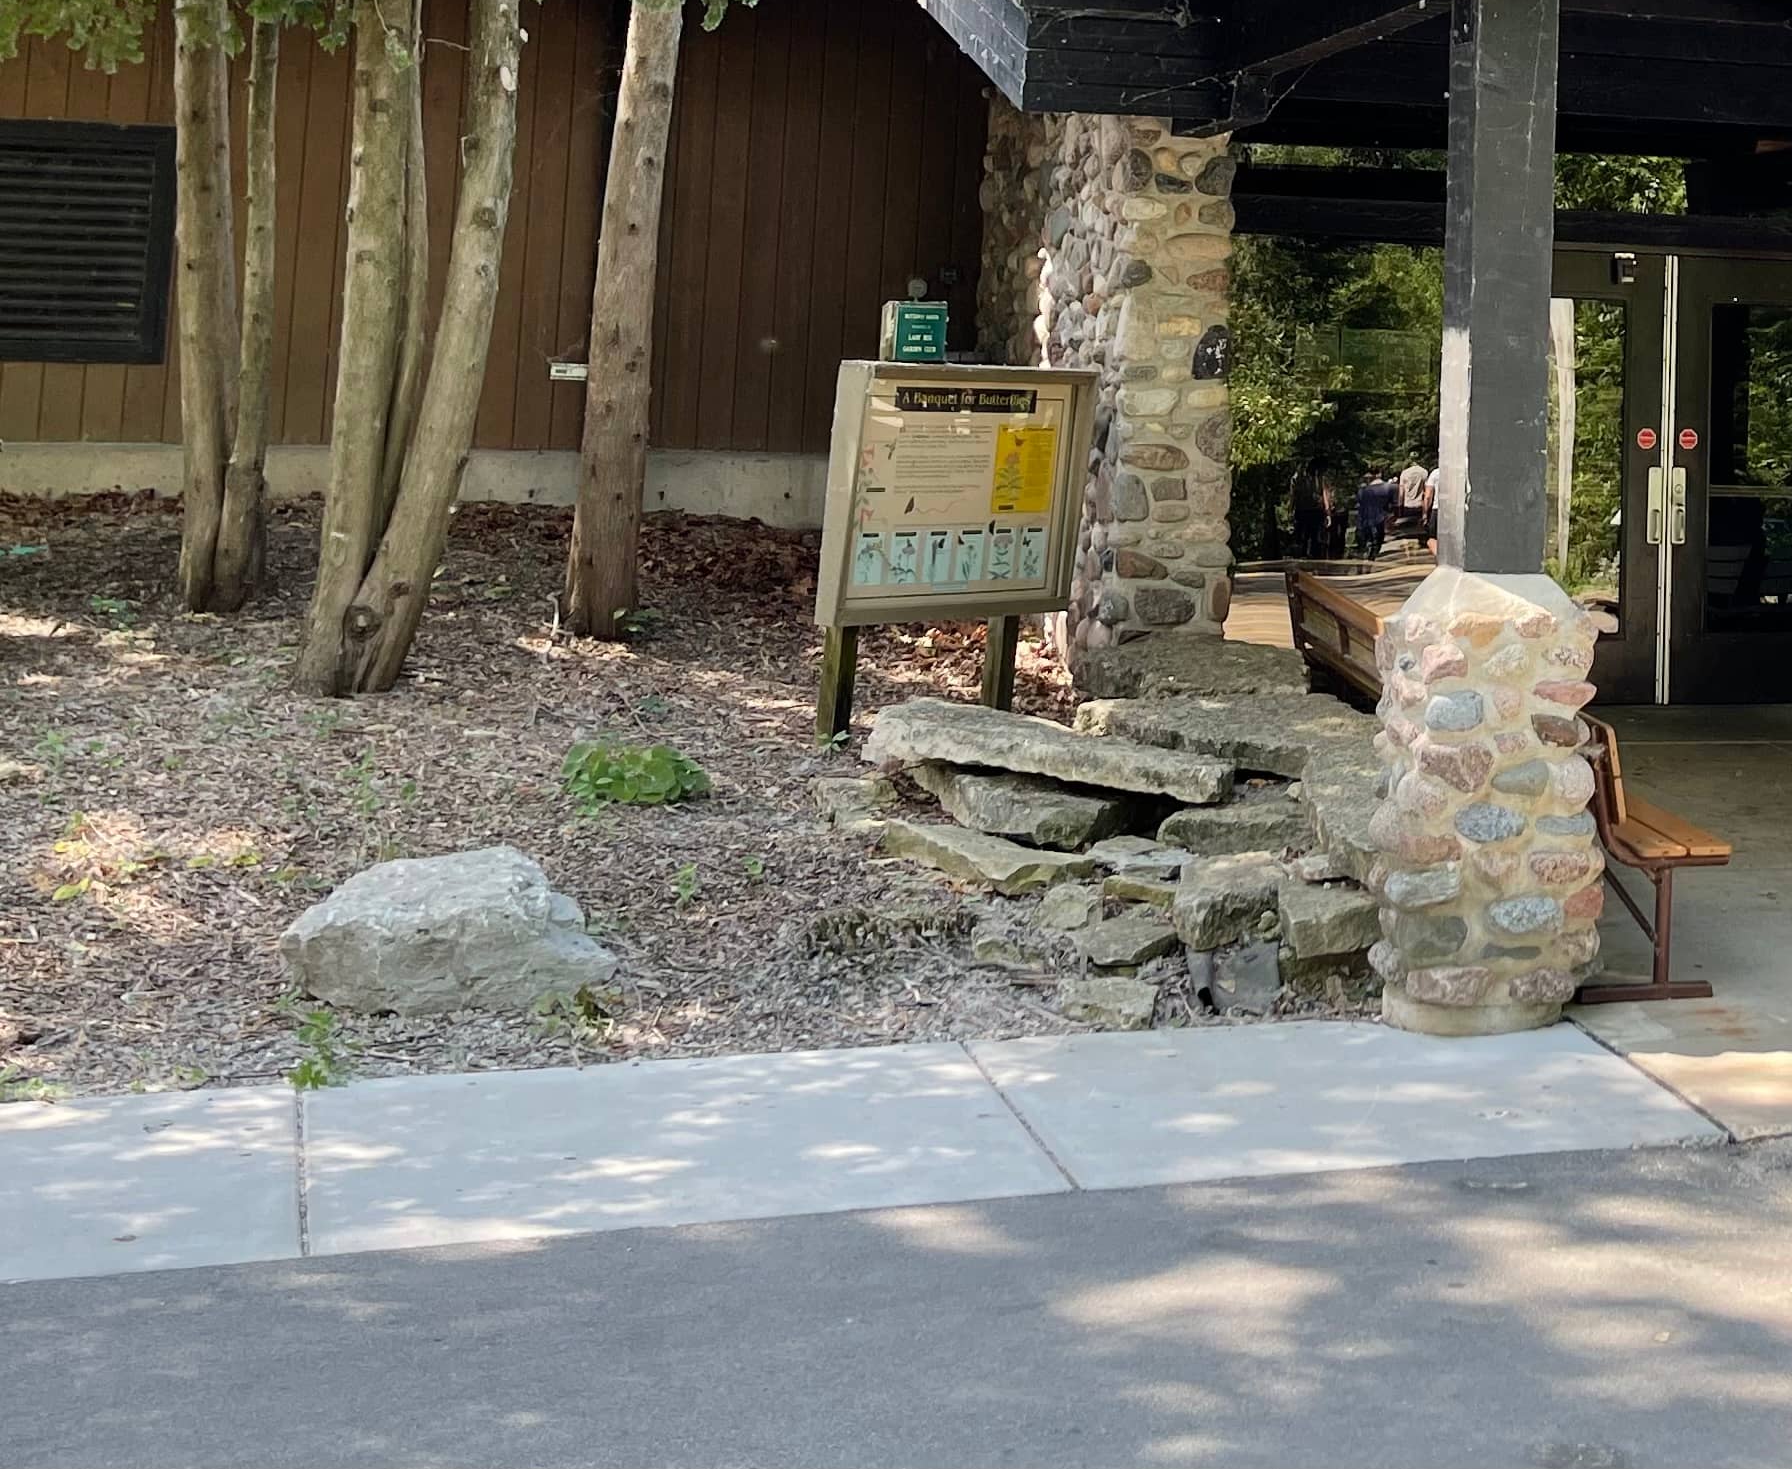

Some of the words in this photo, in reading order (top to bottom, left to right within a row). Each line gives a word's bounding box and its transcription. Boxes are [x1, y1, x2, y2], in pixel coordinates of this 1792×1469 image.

[902, 392, 910, 404] A
[913, 392, 958, 407] Banquet
[960, 392, 977, 405] for
[979, 393, 1032, 406] Butterflies
